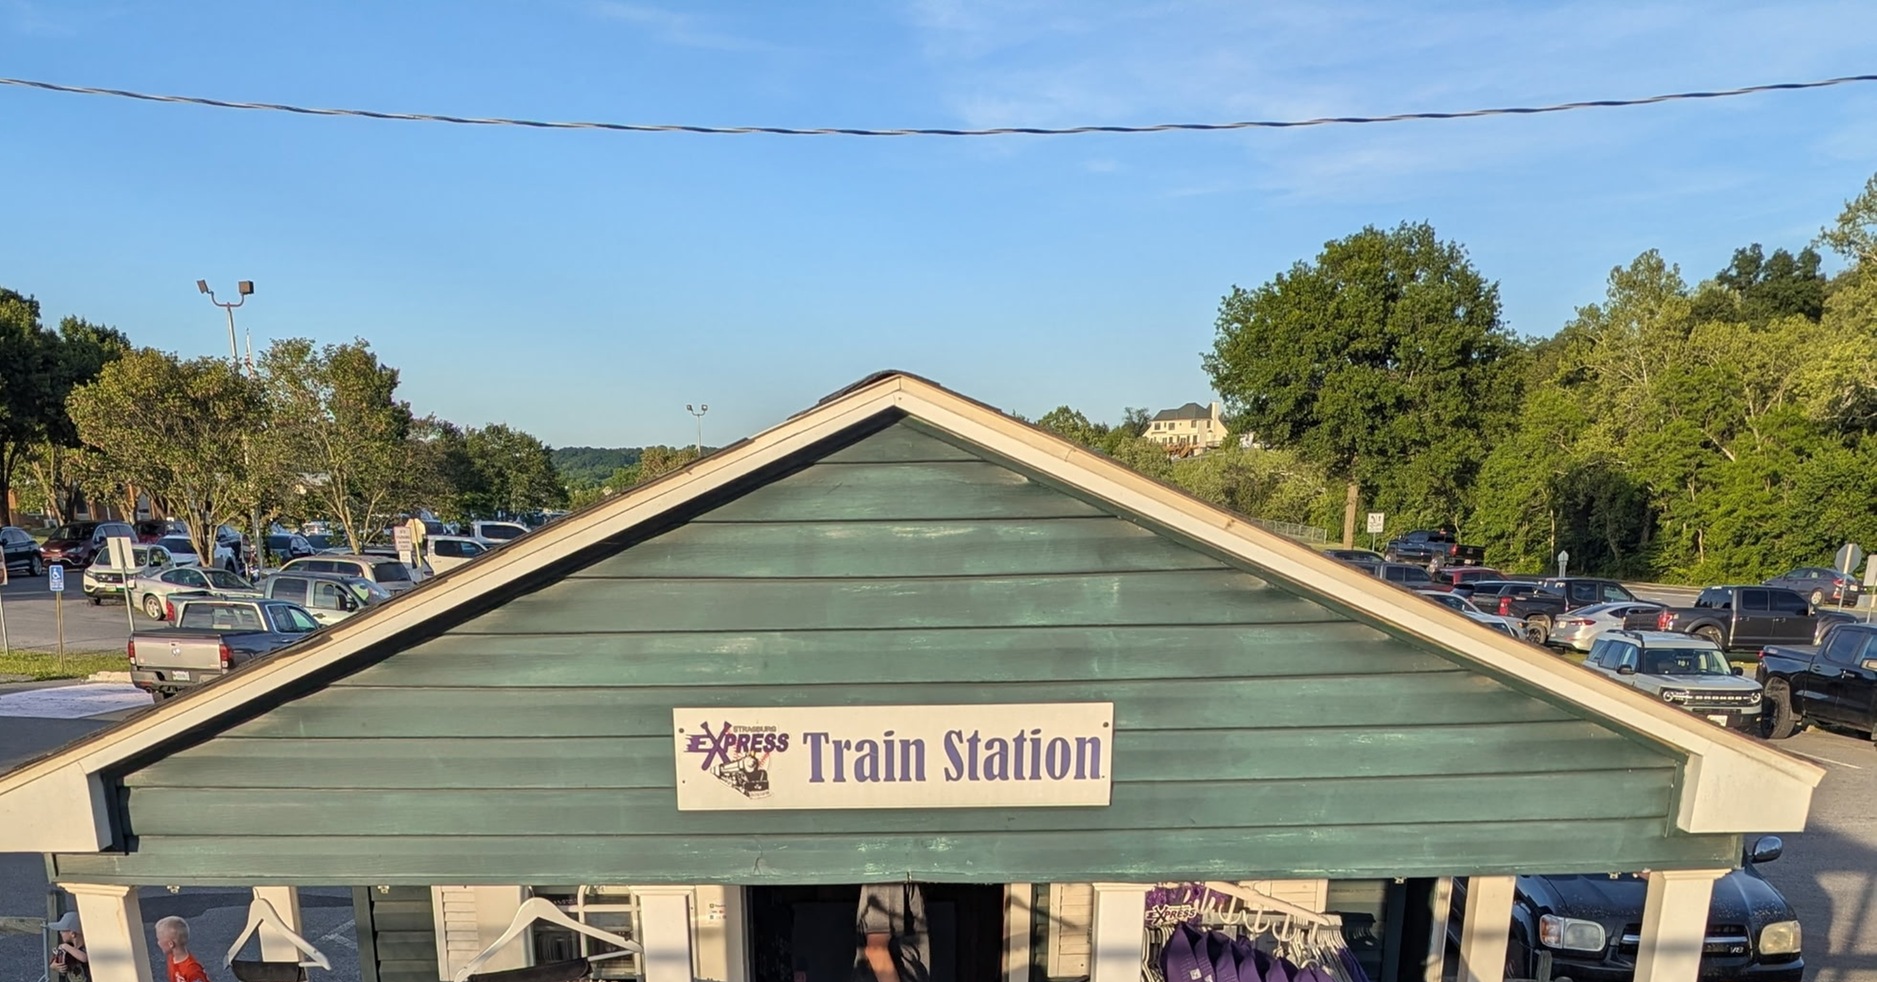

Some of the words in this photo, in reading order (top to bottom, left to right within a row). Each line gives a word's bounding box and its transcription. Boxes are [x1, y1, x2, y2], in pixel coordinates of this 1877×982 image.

[683, 721, 790, 771] EXPRESS
[733, 725, 777, 733] STRASBURG
[803, 730, 926, 783] Train
[944, 729, 1102, 782] Station
[1145, 905, 1196, 925] EXPRESS
